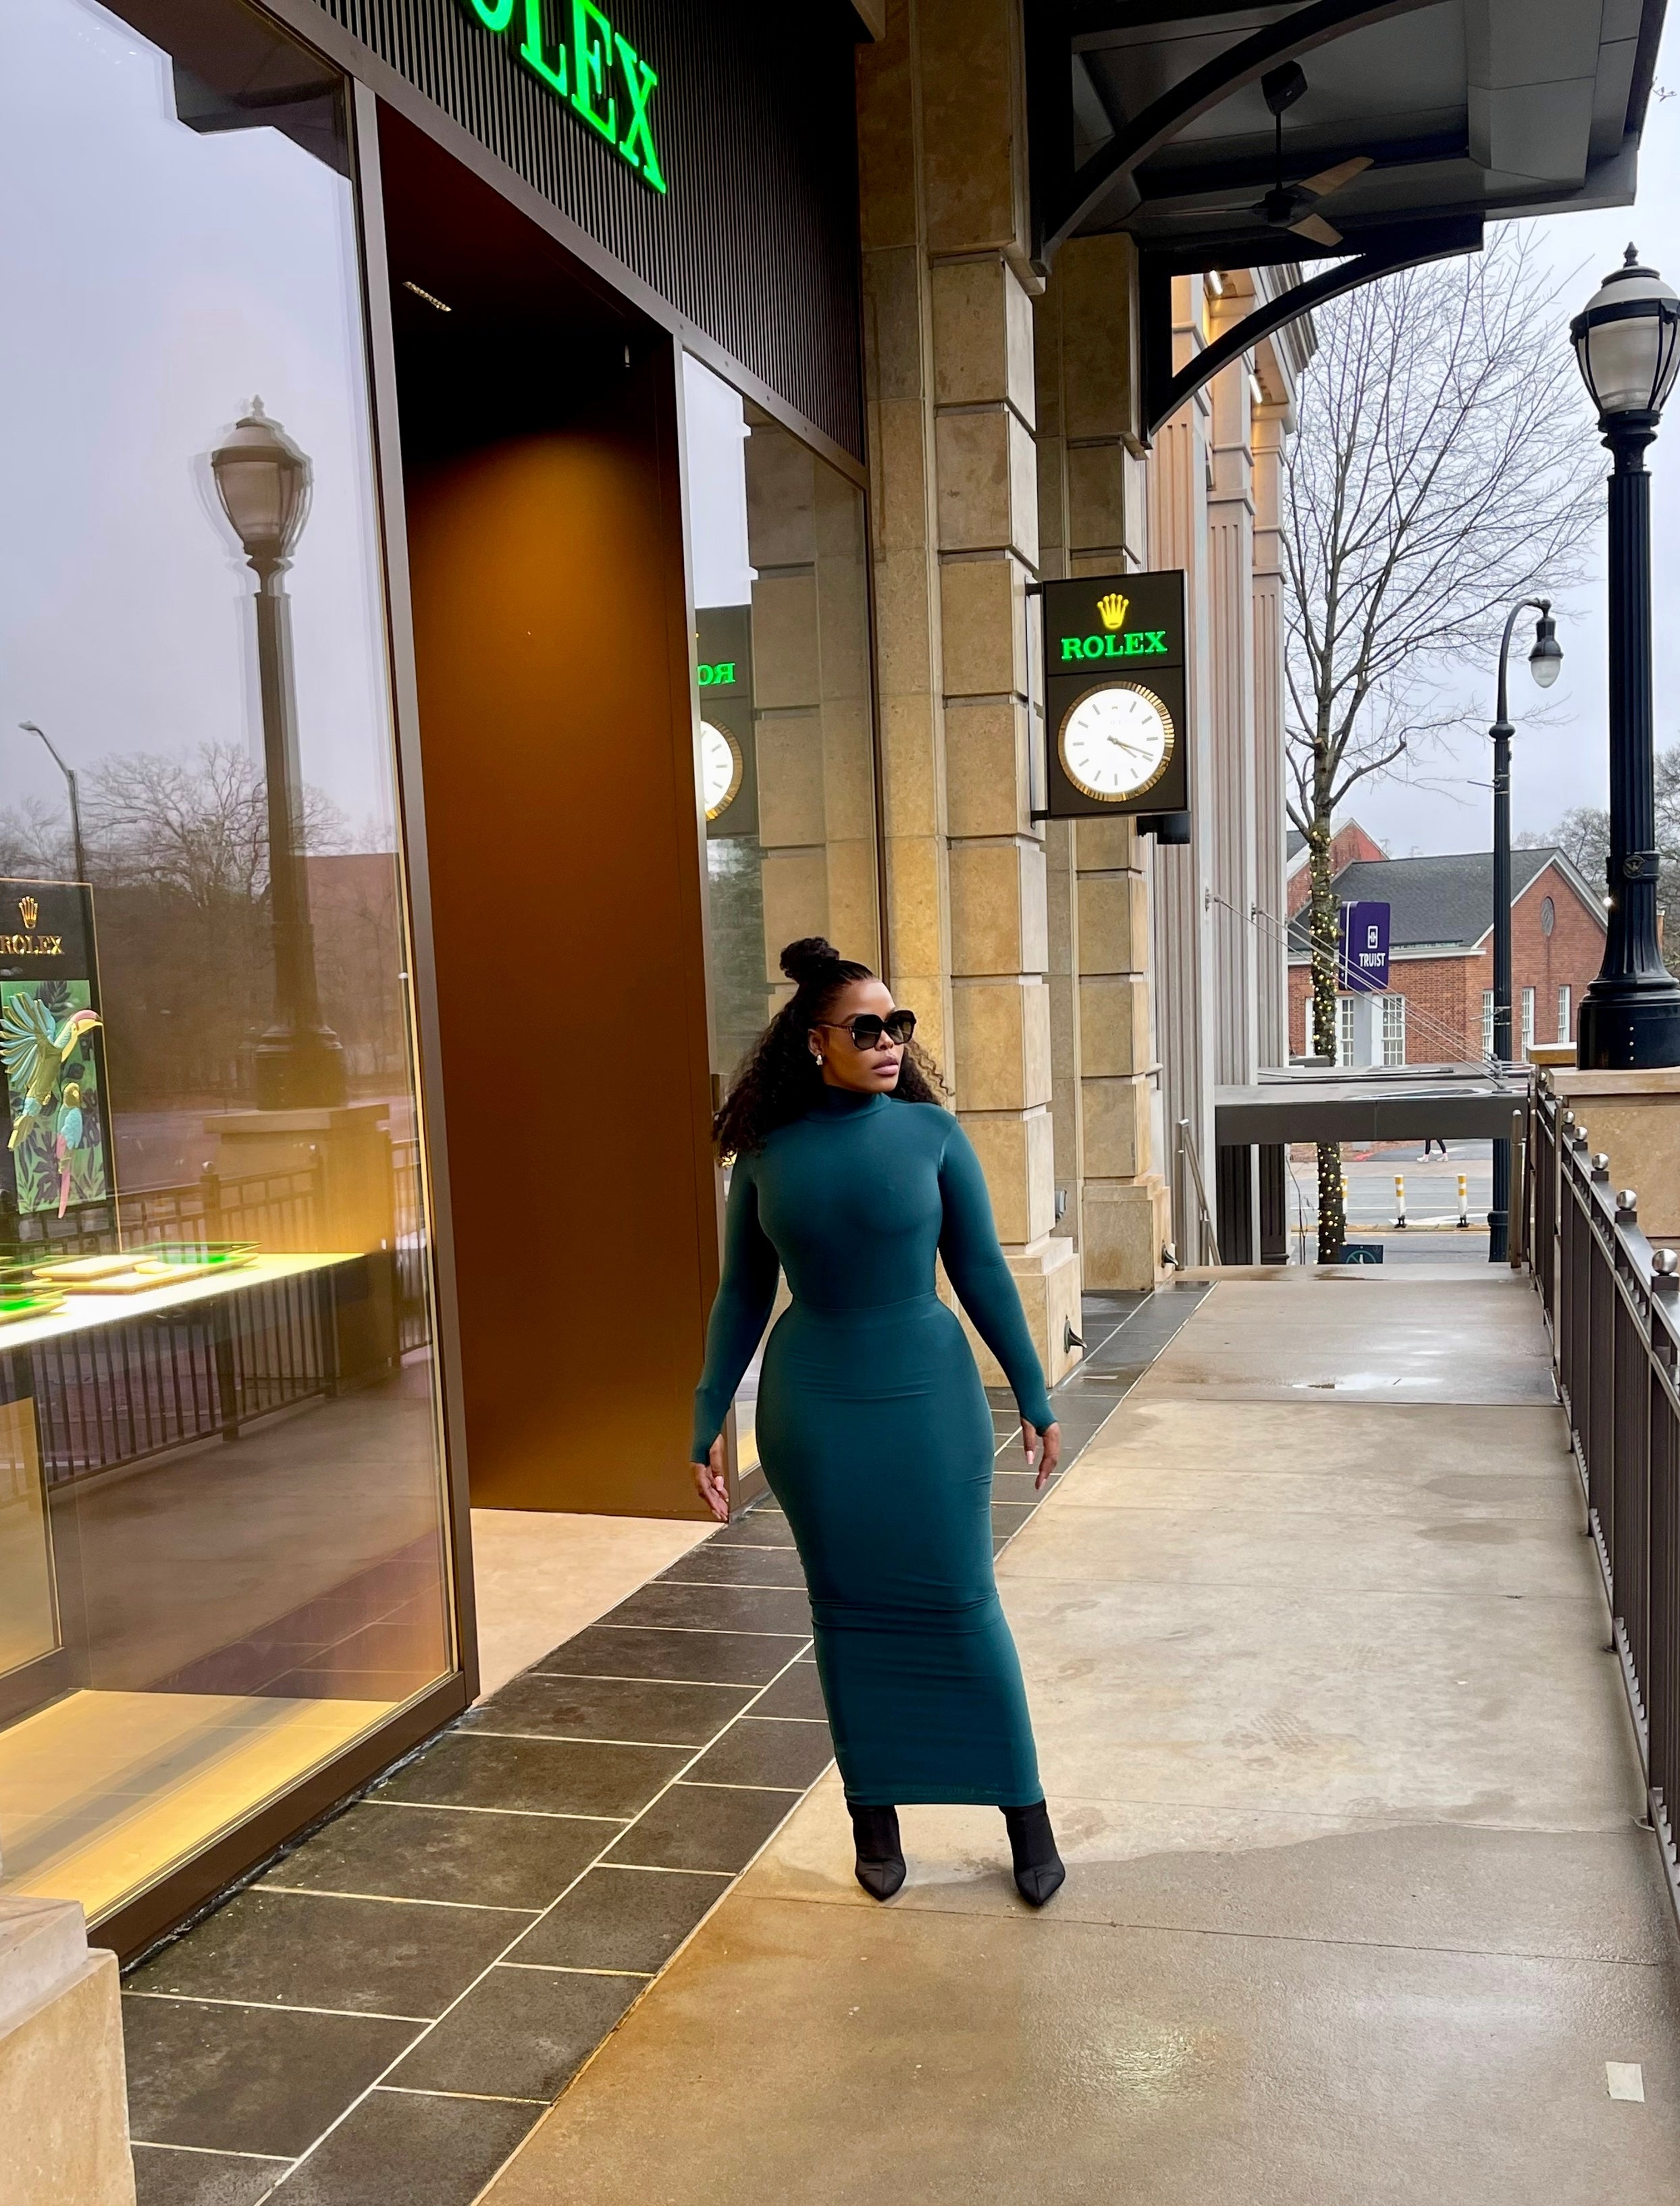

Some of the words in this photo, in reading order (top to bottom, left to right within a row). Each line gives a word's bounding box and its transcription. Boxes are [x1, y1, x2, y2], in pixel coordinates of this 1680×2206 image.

[1061, 631, 1167, 661] ROLEX
[0, 934, 64, 955] ROLEX
[1359, 952, 1386, 968] TRUIST
